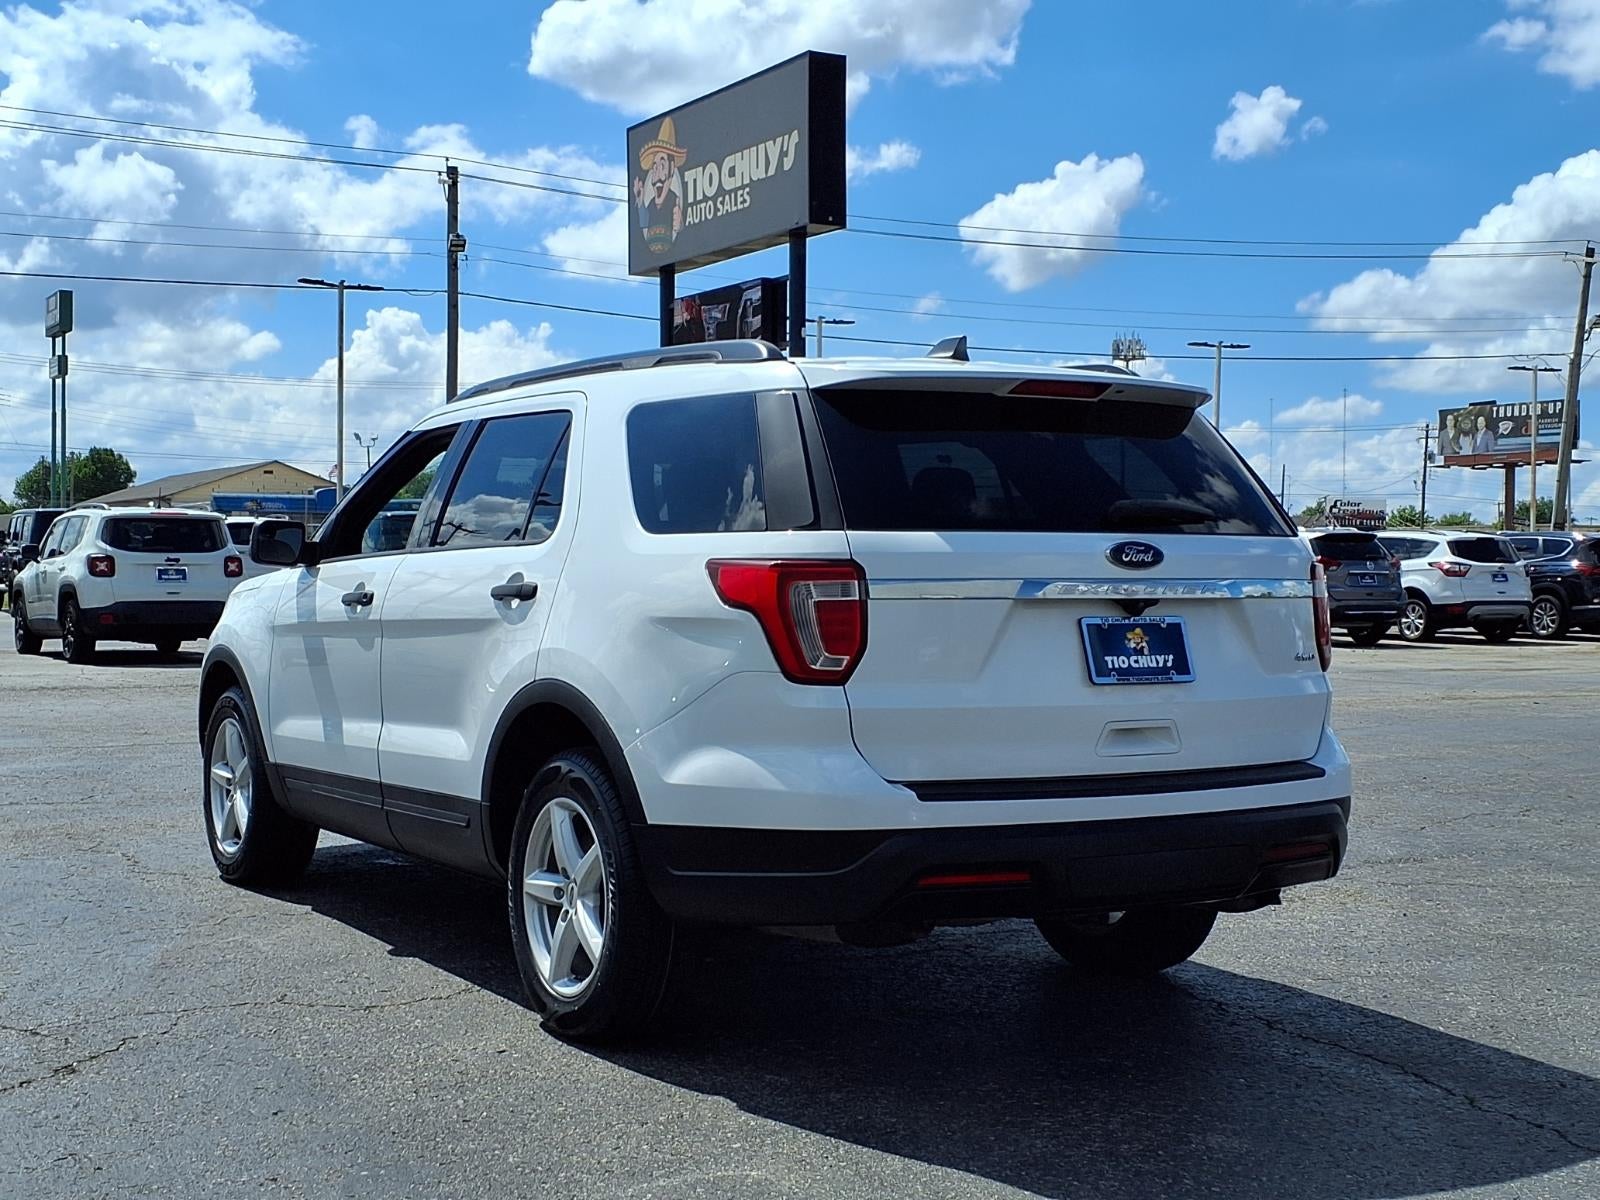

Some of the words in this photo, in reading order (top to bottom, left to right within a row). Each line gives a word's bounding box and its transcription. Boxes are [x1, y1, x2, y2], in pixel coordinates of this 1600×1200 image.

[684, 162, 719, 203] TIO
[721, 129, 799, 191] CHUY'S
[685, 200, 715, 226] AUTO
[717, 187, 751, 217] SALES
[1492, 403, 1542, 418] THUNDER
[1548, 402, 1562, 413] UP
[1333, 499, 1362, 508] Color
[1122, 545, 1154, 562] Ford
